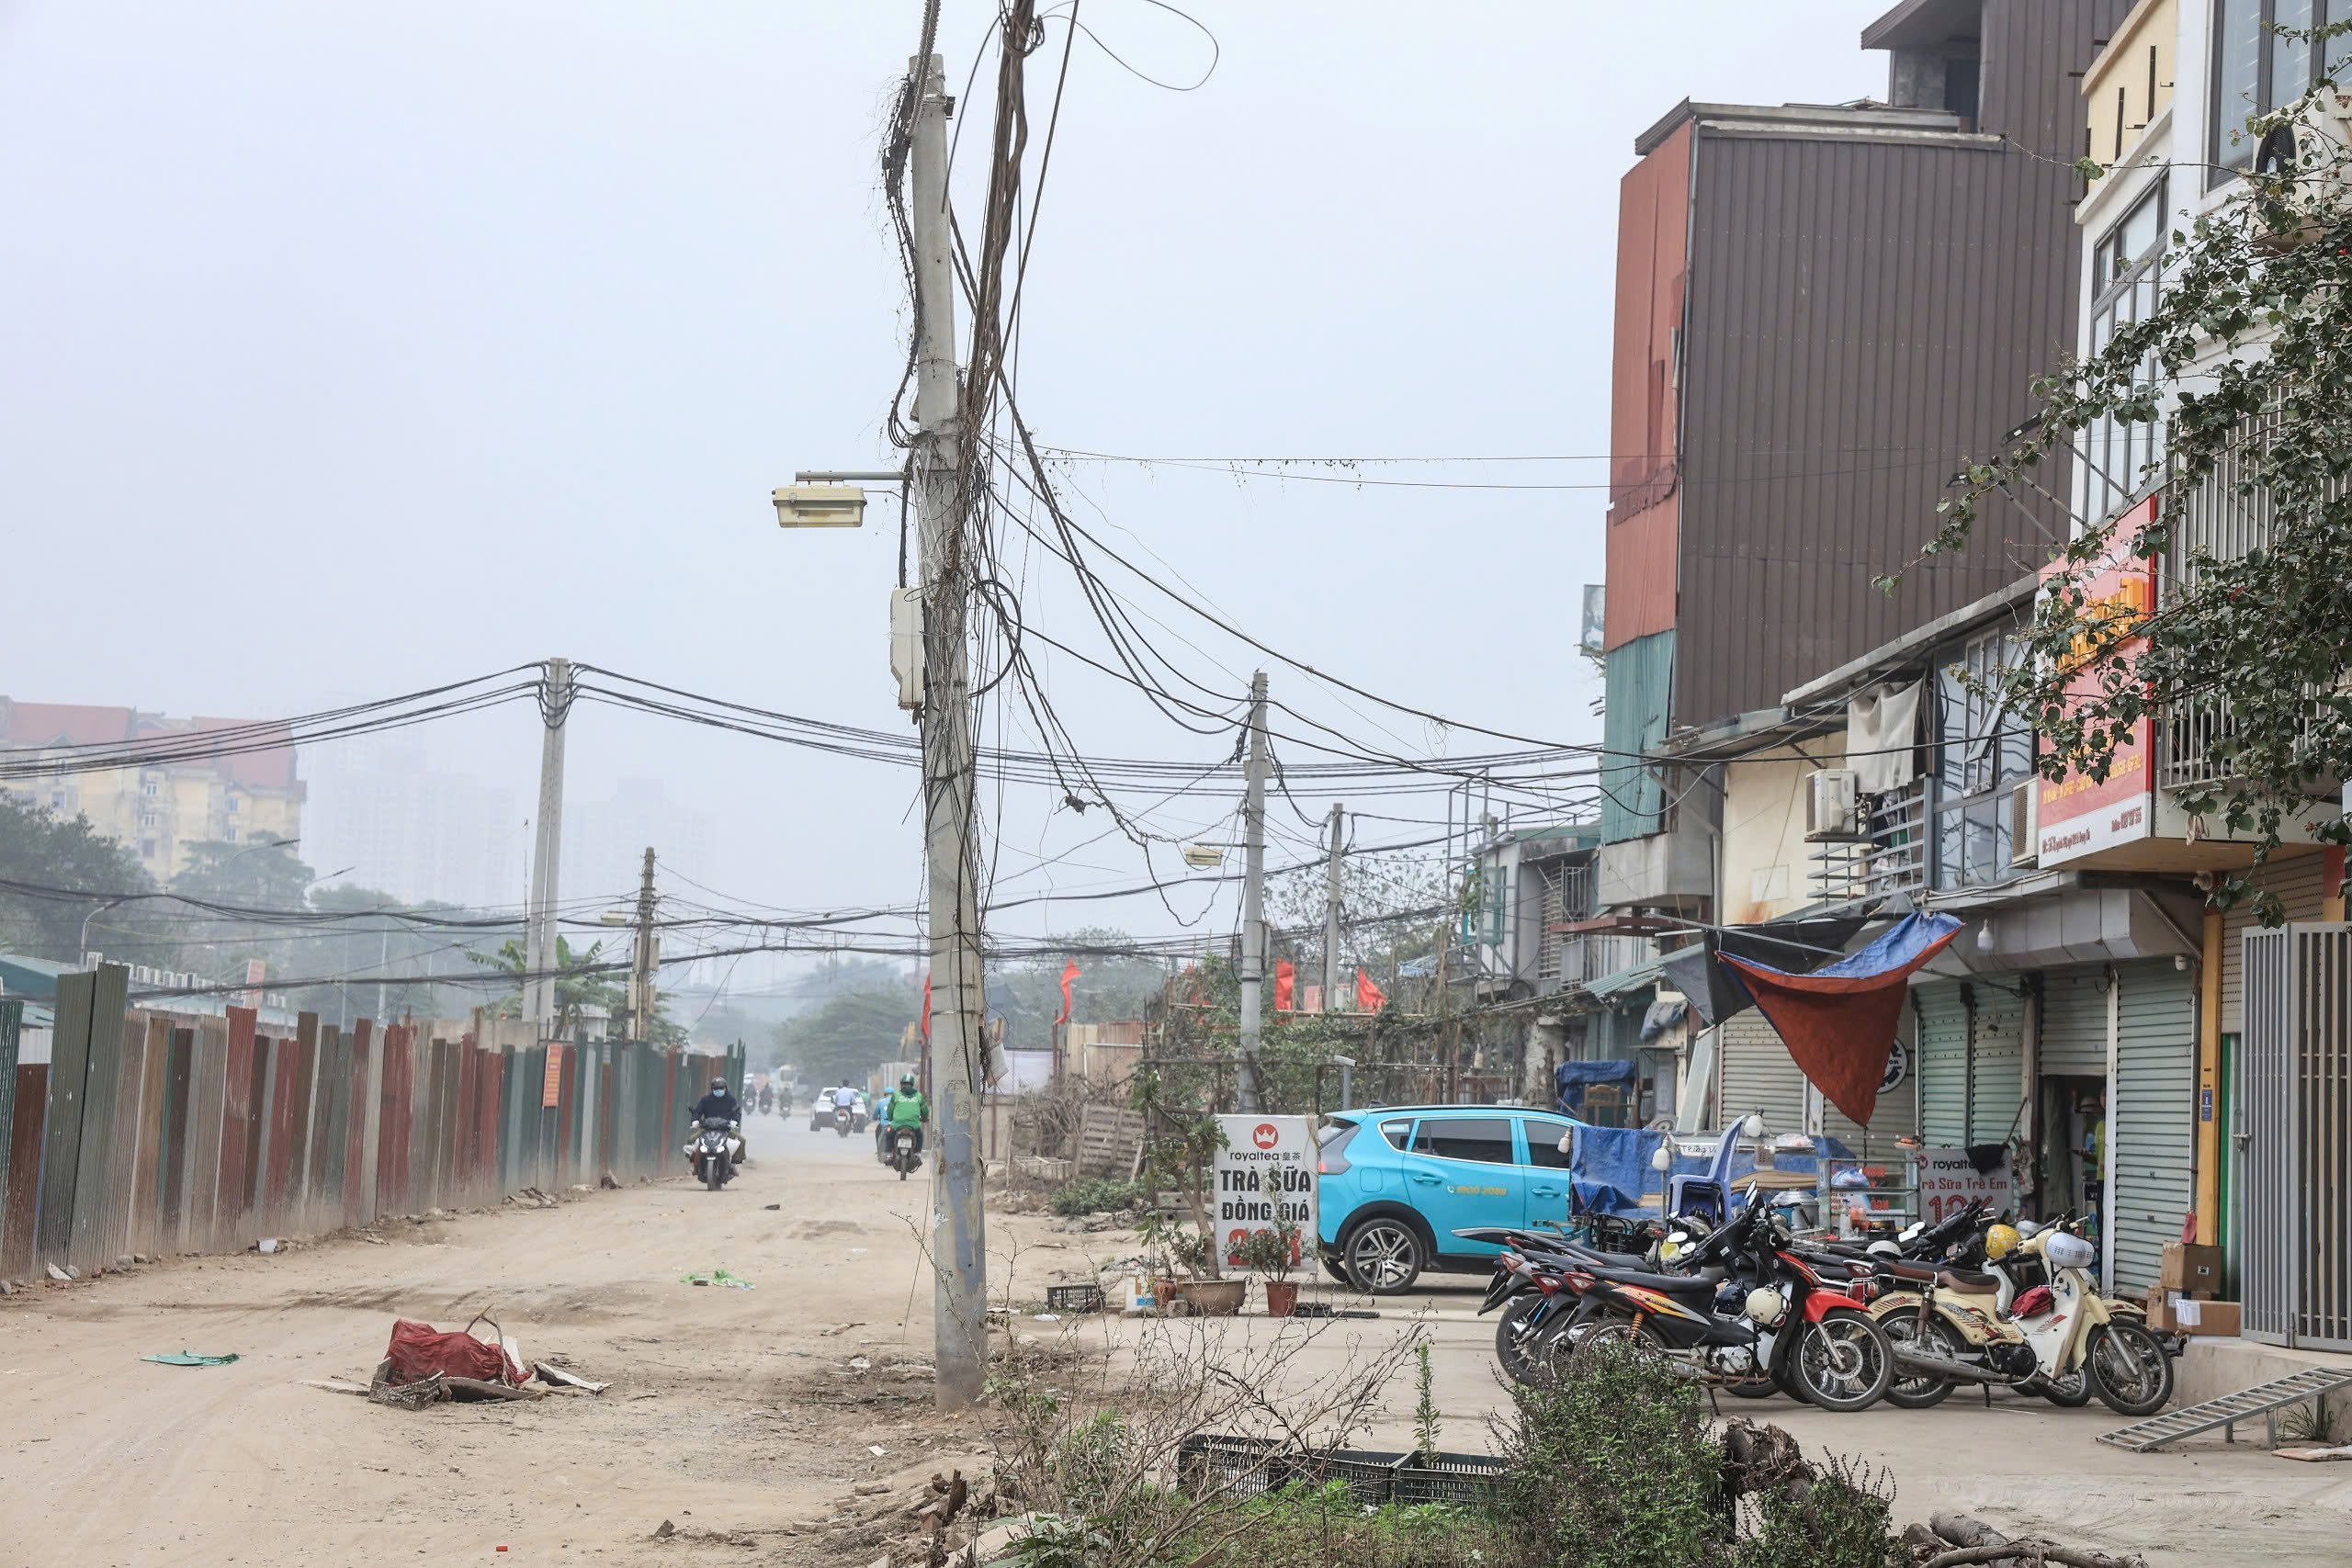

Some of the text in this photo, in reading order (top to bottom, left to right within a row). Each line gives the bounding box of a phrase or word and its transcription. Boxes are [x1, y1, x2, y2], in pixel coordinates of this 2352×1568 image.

[1229, 1151, 1280, 1162] royaltea
[1933, 1159, 1976, 1171] royalte
[1220, 1166, 1311, 1192] TRÀ SỮA
[1989, 1178, 2007, 1190] Em
[1221, 1195, 1272, 1221] ĐỒNG
